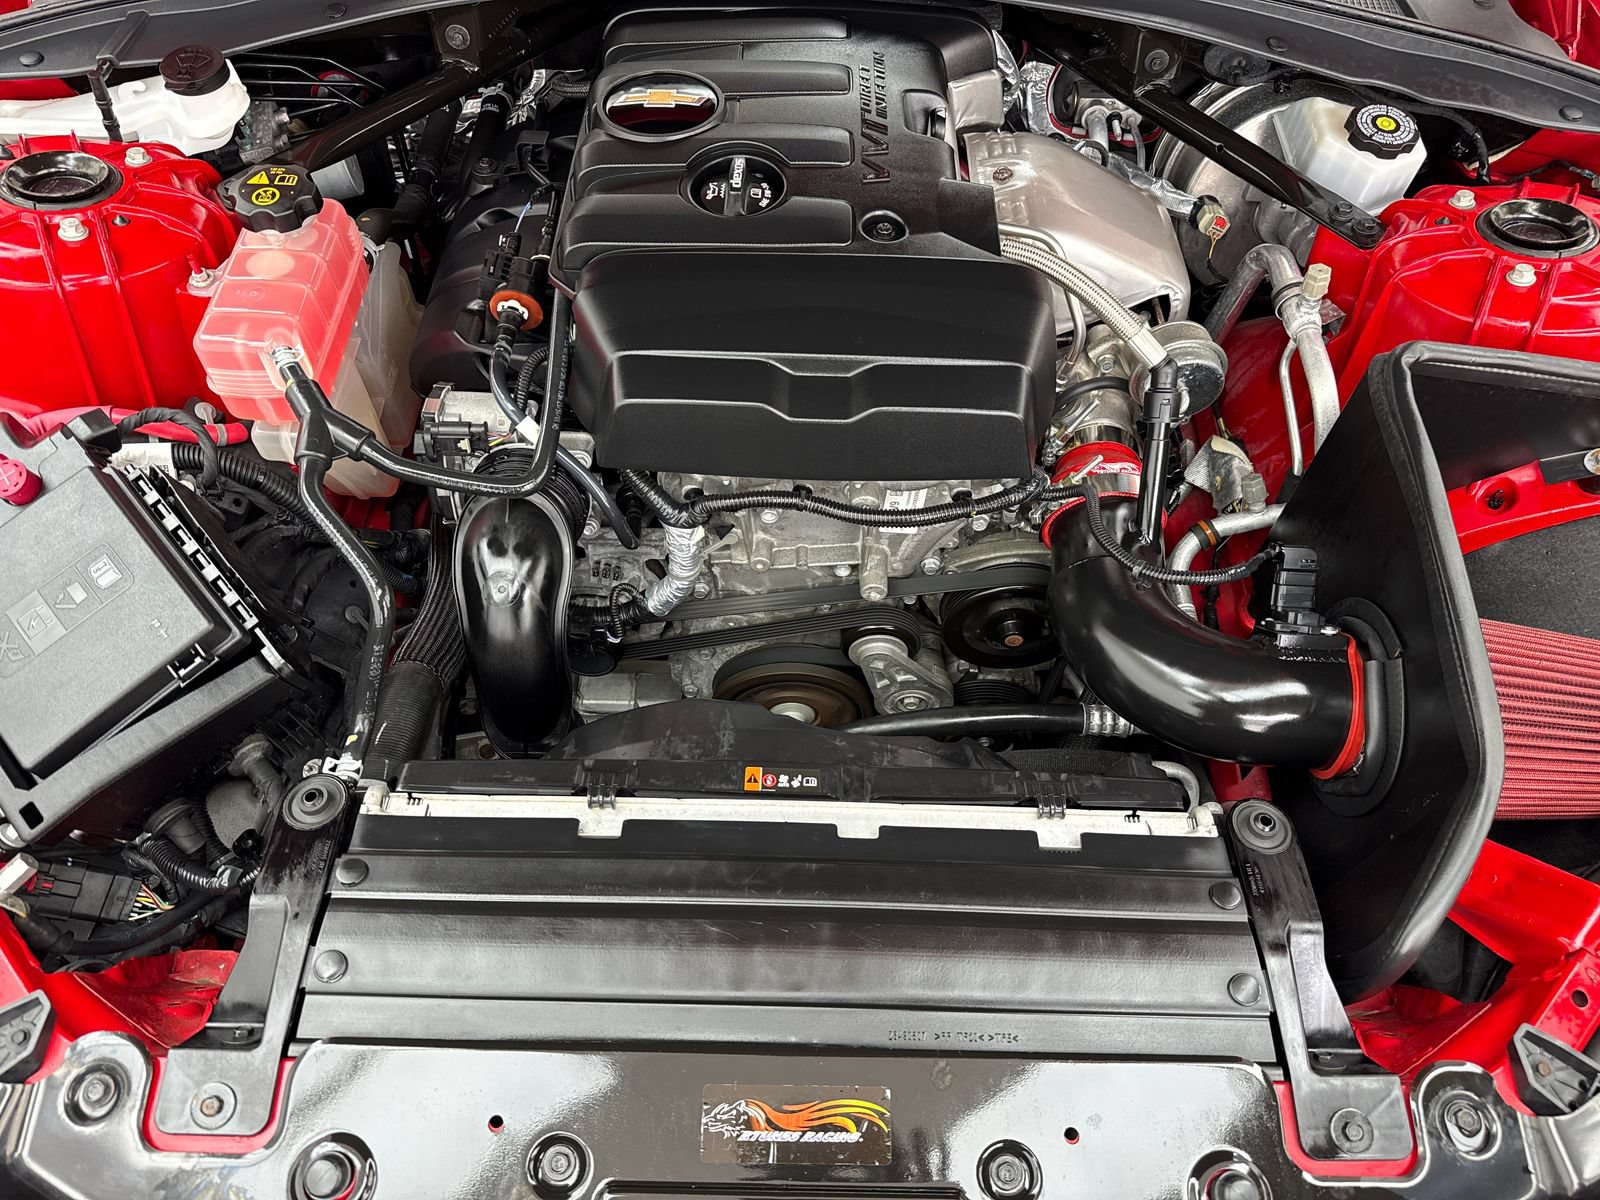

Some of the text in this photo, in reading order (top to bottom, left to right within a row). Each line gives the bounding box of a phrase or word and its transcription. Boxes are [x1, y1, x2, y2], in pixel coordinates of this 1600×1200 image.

[859, 63, 872, 114] DIRECT
[873, 50, 888, 120] INJECTION
[729, 157, 744, 188] dexos
[861, 111, 890, 184] VVT
